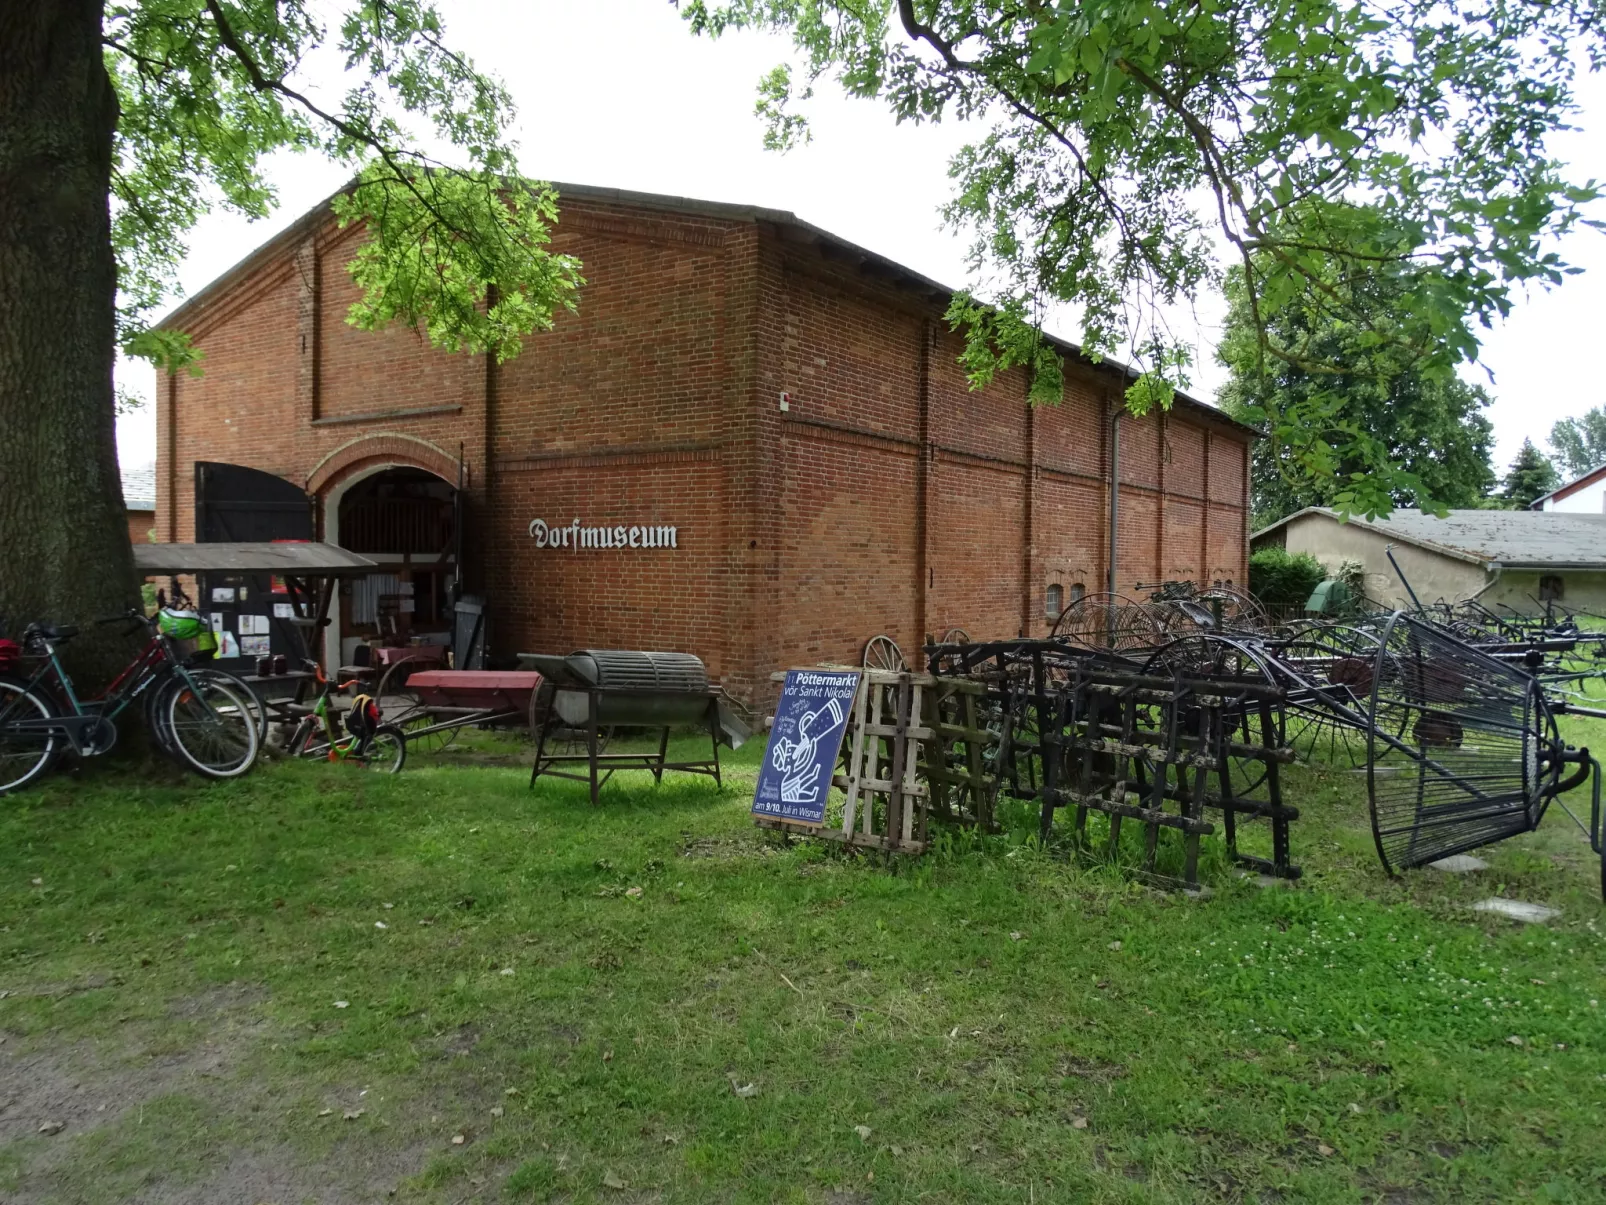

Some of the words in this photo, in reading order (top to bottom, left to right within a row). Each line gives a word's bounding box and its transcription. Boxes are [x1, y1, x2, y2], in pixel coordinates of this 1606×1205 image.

[529, 518, 677, 555] Dorfmuseum
[796, 672, 857, 687] Pöttermarkt
[784, 685, 798, 696] vör
[799, 685, 823, 697] Sankt
[824, 686, 854, 699] Nikolai
[755, 802, 765, 810] am
[765, 802, 781, 813] 9/10.
[782, 805, 792, 814] Juli
[792, 806, 798, 815] in
[799, 807, 822, 819] Wismar
